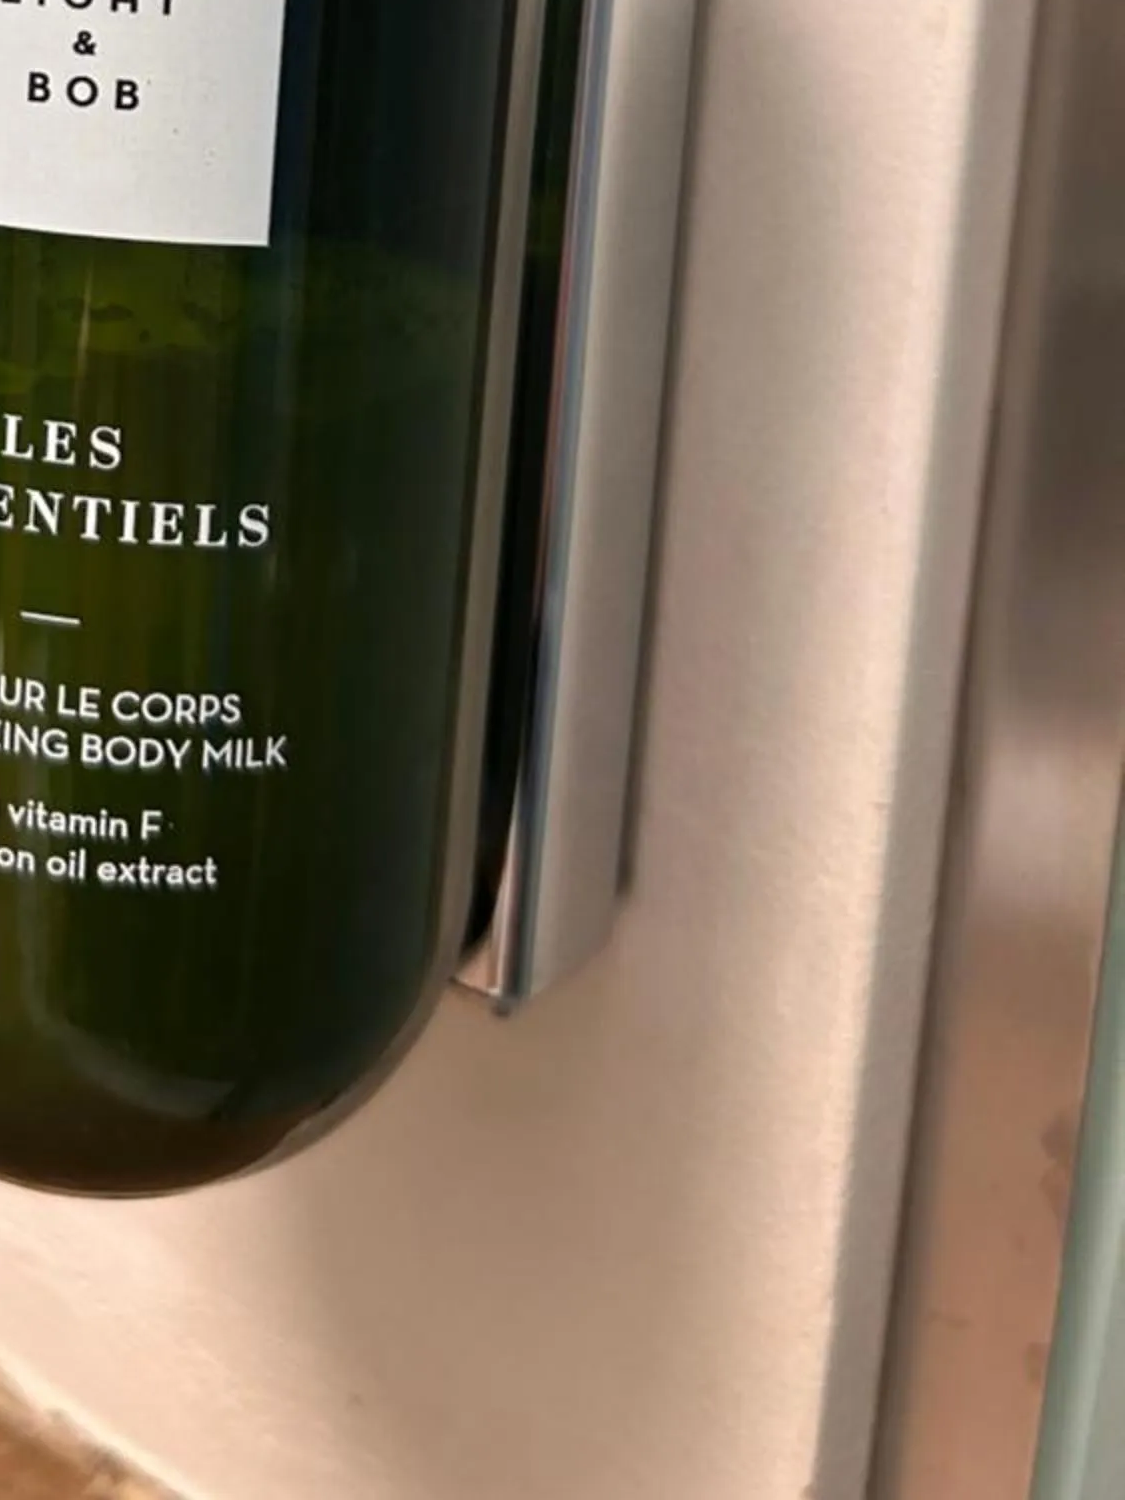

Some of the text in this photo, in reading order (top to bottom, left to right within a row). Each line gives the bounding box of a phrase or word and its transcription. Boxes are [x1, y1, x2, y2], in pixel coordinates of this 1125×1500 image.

[72, 30, 97, 56] &
[27, 71, 140, 112] BOB
[1, 413, 123, 471] LES
[56, 684, 100, 719] LE
[111, 690, 242, 725] CORPS
[80, 734, 192, 769] BODY
[202, 735, 288, 769] MILK
[7, 799, 129, 840] vitamin
[140, 809, 164, 840] F
[46, 849, 87, 881] oil
[96, 855, 218, 887] extract
